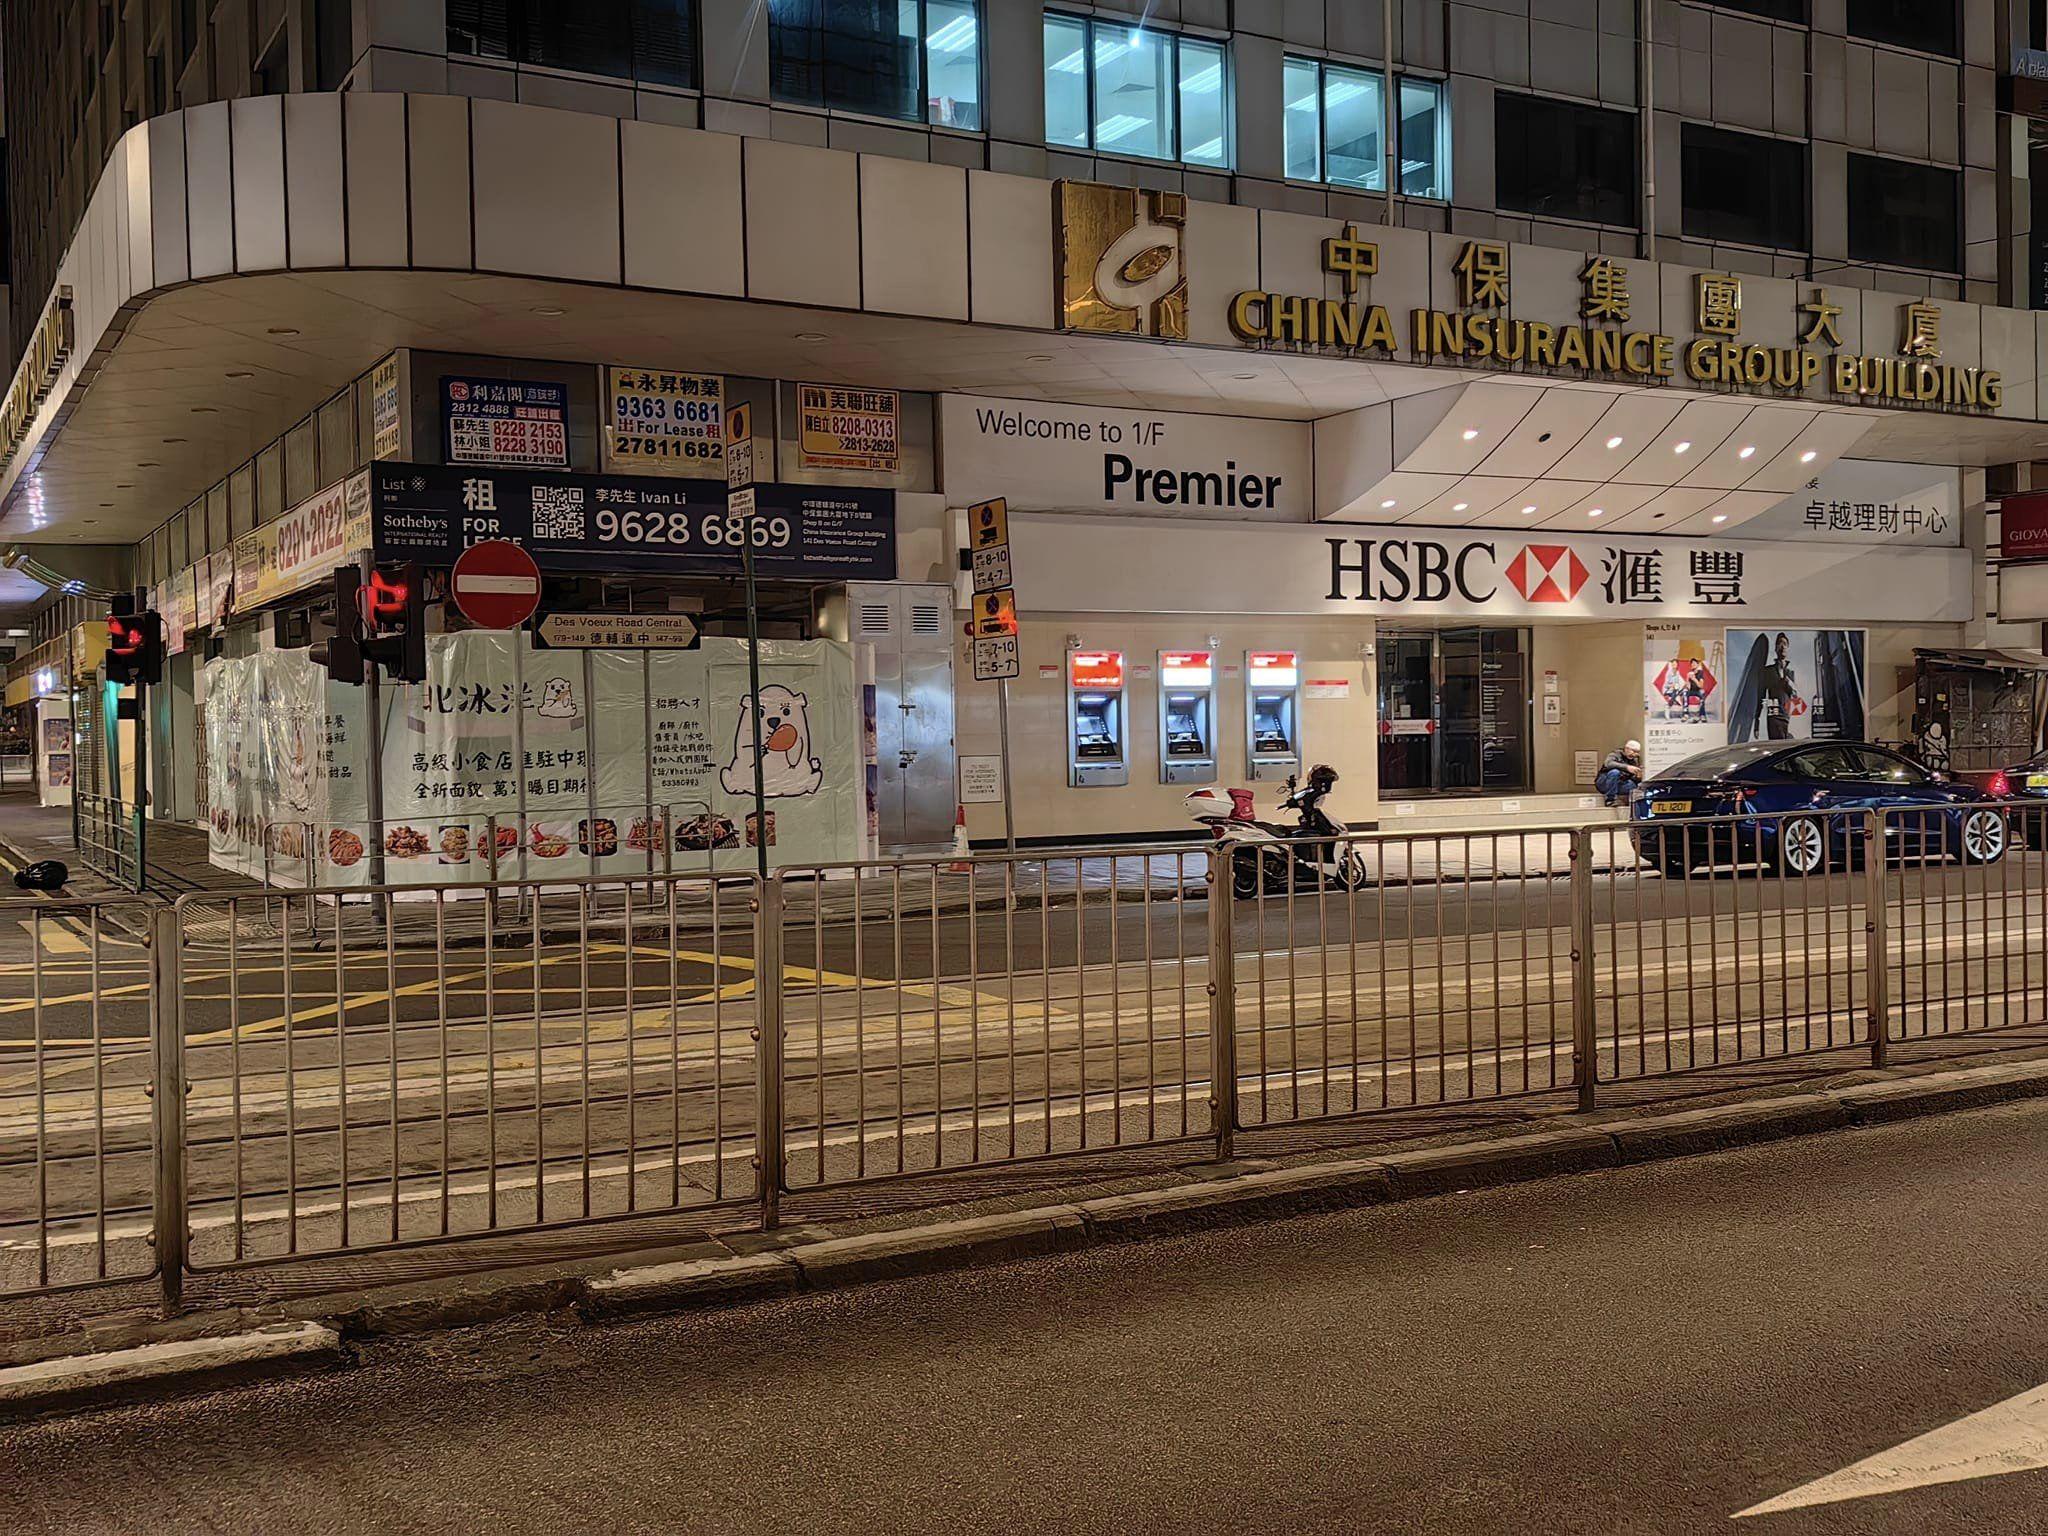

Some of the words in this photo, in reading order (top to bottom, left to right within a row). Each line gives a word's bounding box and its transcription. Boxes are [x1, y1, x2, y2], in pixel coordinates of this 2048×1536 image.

[1322, 225, 1943, 358] 中保集團大廈
[1228, 290, 1397, 351] CHINA
[1410, 308, 1675, 377] INSURANCE
[1684, 338, 1822, 390] GROUP
[1828, 354, 2003, 410] BUILDING
[637, 373, 720, 397] 永昇物業
[451, 403, 479, 414] 2812
[616, 396, 666, 418] 9363
[673, 400, 720, 423] 6681
[493, 421, 526, 437] 8228
[530, 422, 562, 438] 2153
[618, 419, 633, 432] 出
[637, 421, 660, 434] For
[664, 423, 704, 437] Lease
[706, 424, 722, 438] 租
[832, 416, 893, 438] 8208-0313
[976, 408, 1091, 441] Welcome
[1100, 422, 1123, 443] to
[1132, 422, 1164, 446] 1/F
[454, 436, 490, 449] 林小姐
[494, 439, 527, 453] 8228
[531, 440, 563, 455] 3190
[616, 437, 723, 459] 27811682
[382, 478, 405, 491] List
[1104, 453, 1283, 509] Premier
[462, 478, 497, 511] 租
[595, 488, 637, 503] 李先生
[641, 493, 670, 504] Ivan
[674, 493, 686, 504] Li
[383, 514, 448, 531] Sotheby's
[463, 518, 500, 533] FOR
[1804, 500, 1948, 534] 卓越理財中心
[595, 509, 690, 544] 9628
[701, 514, 791, 548] 6869
[985, 550, 1007, 565] 8-10
[1324, 538, 1497, 602] HSBC
[554, 617, 576, 627] Des
[580, 618, 613, 627] Voeux
[616, 617, 642, 627] Road
[646, 618, 682, 627] Central
[590, 632, 649, 645] 德輔道中
[991, 641, 1015, 655] 7-10
[991, 661, 1012, 672] 5-7
[656, 697, 701, 709] 招聘人才
